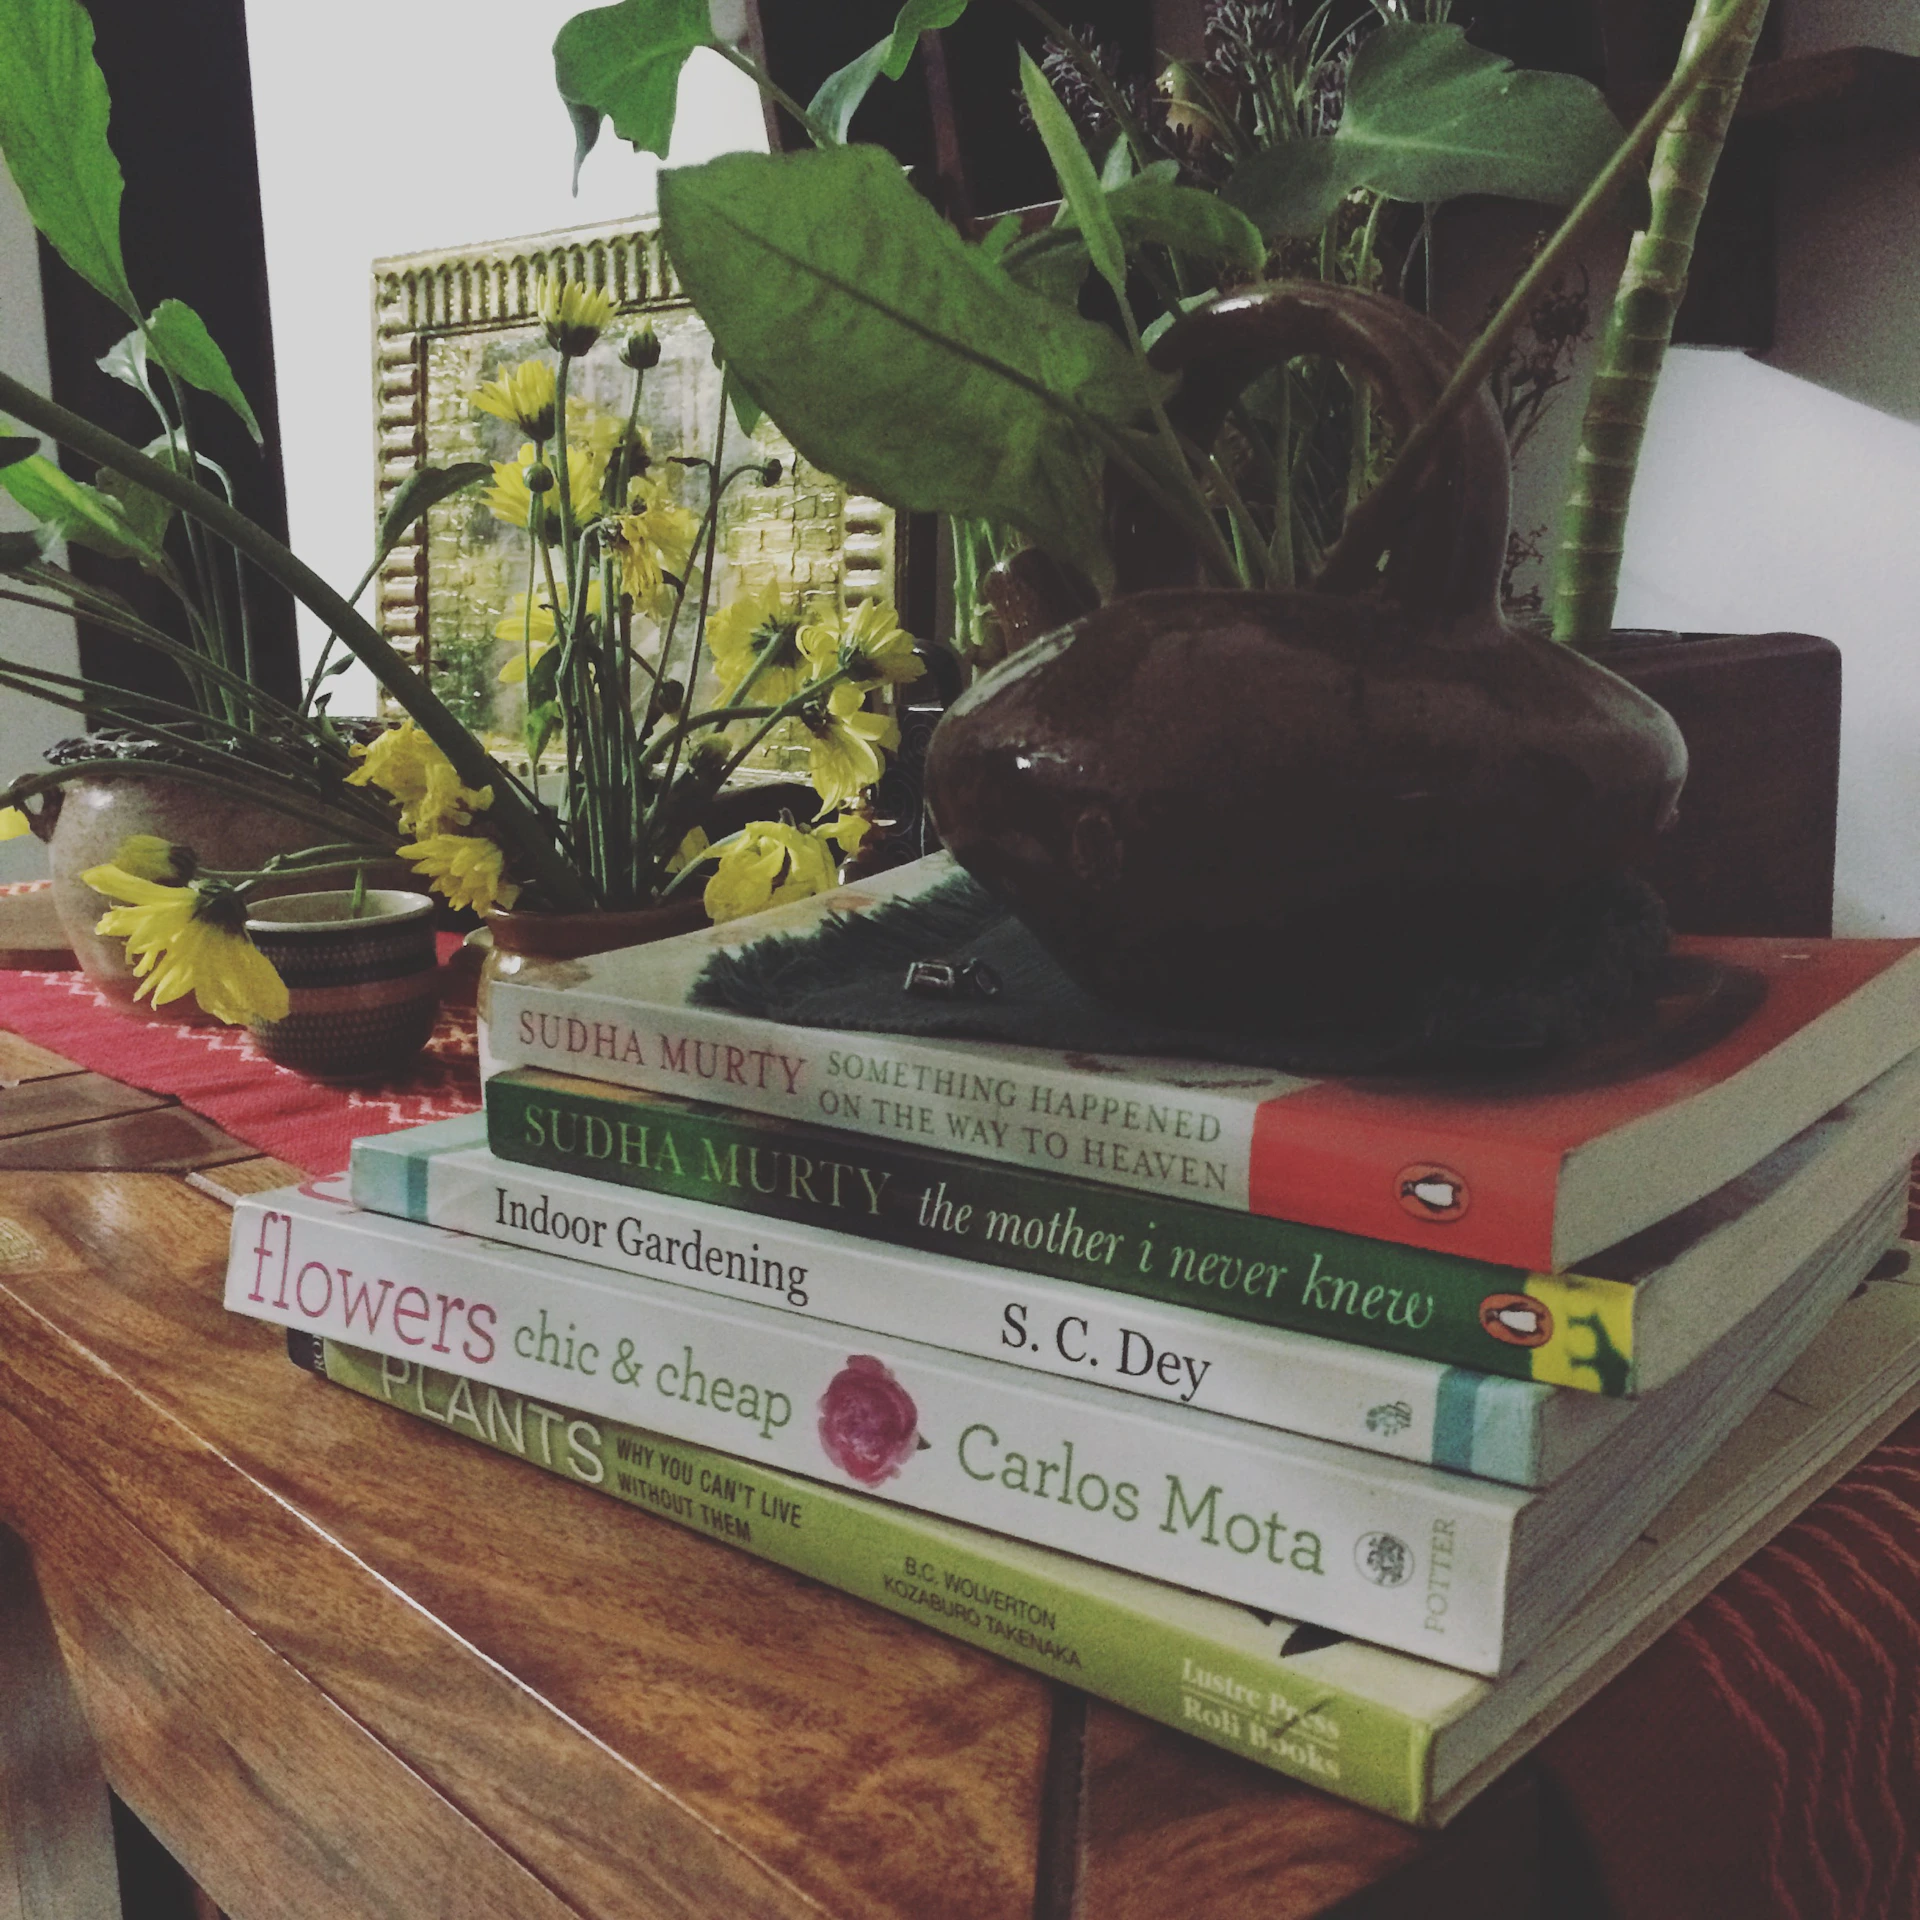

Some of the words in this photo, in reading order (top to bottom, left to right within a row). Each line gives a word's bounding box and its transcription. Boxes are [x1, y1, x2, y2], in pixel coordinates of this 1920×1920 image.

[519, 1010, 646, 1067] SUDHA
[659, 1032, 808, 1096] MURTY
[827, 1050, 1016, 1107] SOMETHING
[1029, 1083, 1222, 1143] HAPPENED
[524, 1104, 684, 1177] SUDHA
[701, 1136, 893, 1217] MURTY
[819, 1088, 861, 1120] ON
[873, 1100, 934, 1136] THE
[945, 1113, 1010, 1148] WAY
[1022, 1127, 1069, 1160] TO
[1083, 1139, 1228, 1191] HEAVEN
[247, 1211, 498, 1364] flowers
[495, 1187, 606, 1248] Indoor
[616, 1217, 809, 1307] Gardening
[918, 1182, 970, 1235] the
[985, 1206, 1125, 1266] mother
[1138, 1221, 1156, 1272] i
[1170, 1245, 1289, 1298] never
[1301, 1254, 1435, 1330] knew
[514, 1309, 600, 1374] chic
[612, 1337, 642, 1387] &
[656, 1346, 792, 1439] cheap
[1001, 1302, 1039, 1353] S.
[1055, 1316, 1099, 1367] C.
[1116, 1328, 1212, 1402] Dey
[382, 1354, 605, 1484] PLANTS
[617, 1437, 654, 1469] WHY
[660, 1453, 693, 1486] YOU
[700, 1469, 755, 1509] CAN'T
[761, 1491, 802, 1528] LIVE
[617, 1472, 693, 1518] WITHOUT
[700, 1504, 751, 1543] THEM
[957, 1423, 1140, 1523] Carlos
[1159, 1474, 1324, 1576] Mota
[883, 1574, 980, 1628] KOZABURO
[985, 1614, 1082, 1670] TAKENAKA
[905, 1557, 938, 1585] B.C.
[944, 1571, 1056, 1631] WOLVERTON
[1424, 1516, 1457, 1634] POTTER
[1182, 1658, 1260, 1709] Lustre
[1183, 1696, 1240, 1738] Roli
